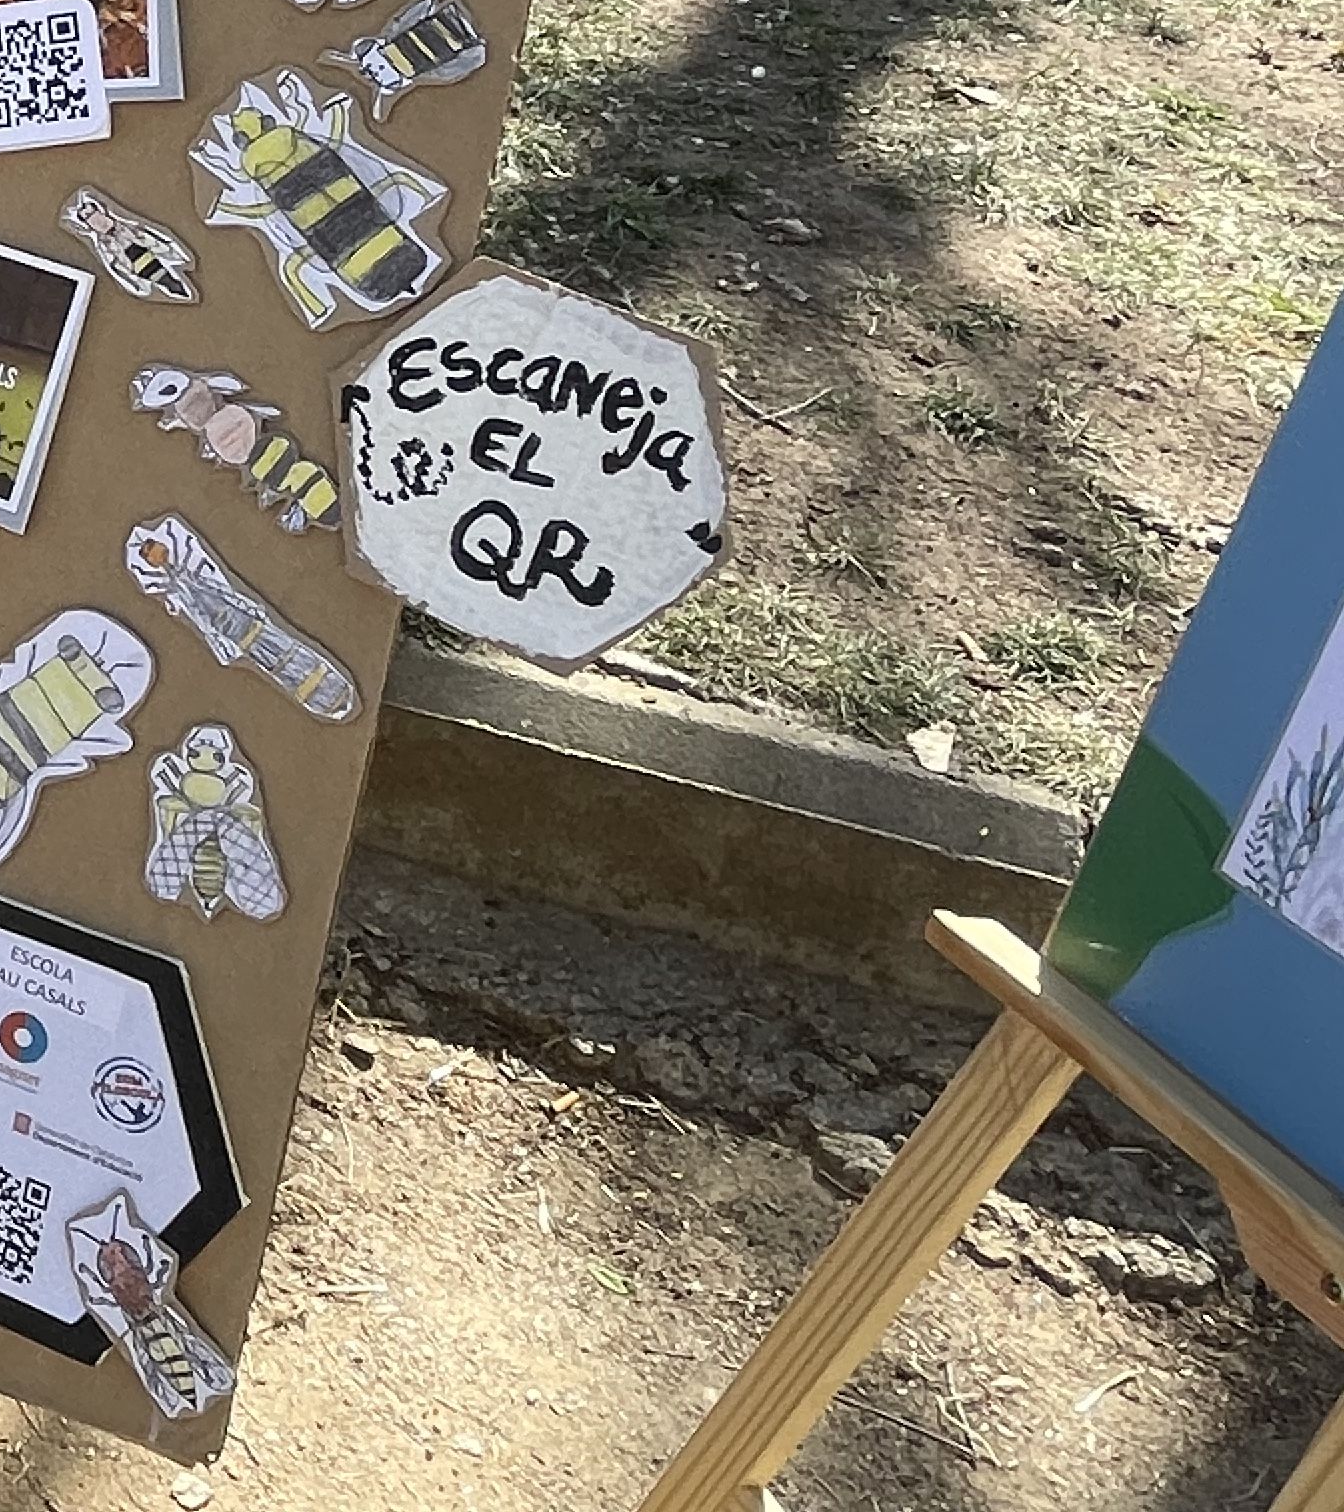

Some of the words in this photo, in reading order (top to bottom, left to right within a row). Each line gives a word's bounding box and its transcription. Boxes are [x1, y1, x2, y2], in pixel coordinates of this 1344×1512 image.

[470, 418, 555, 488] EL
[451, 499, 615, 607] QR
[10, 945, 74, 984] ESCOLA
[23, 978, 88, 1016] CASALS
